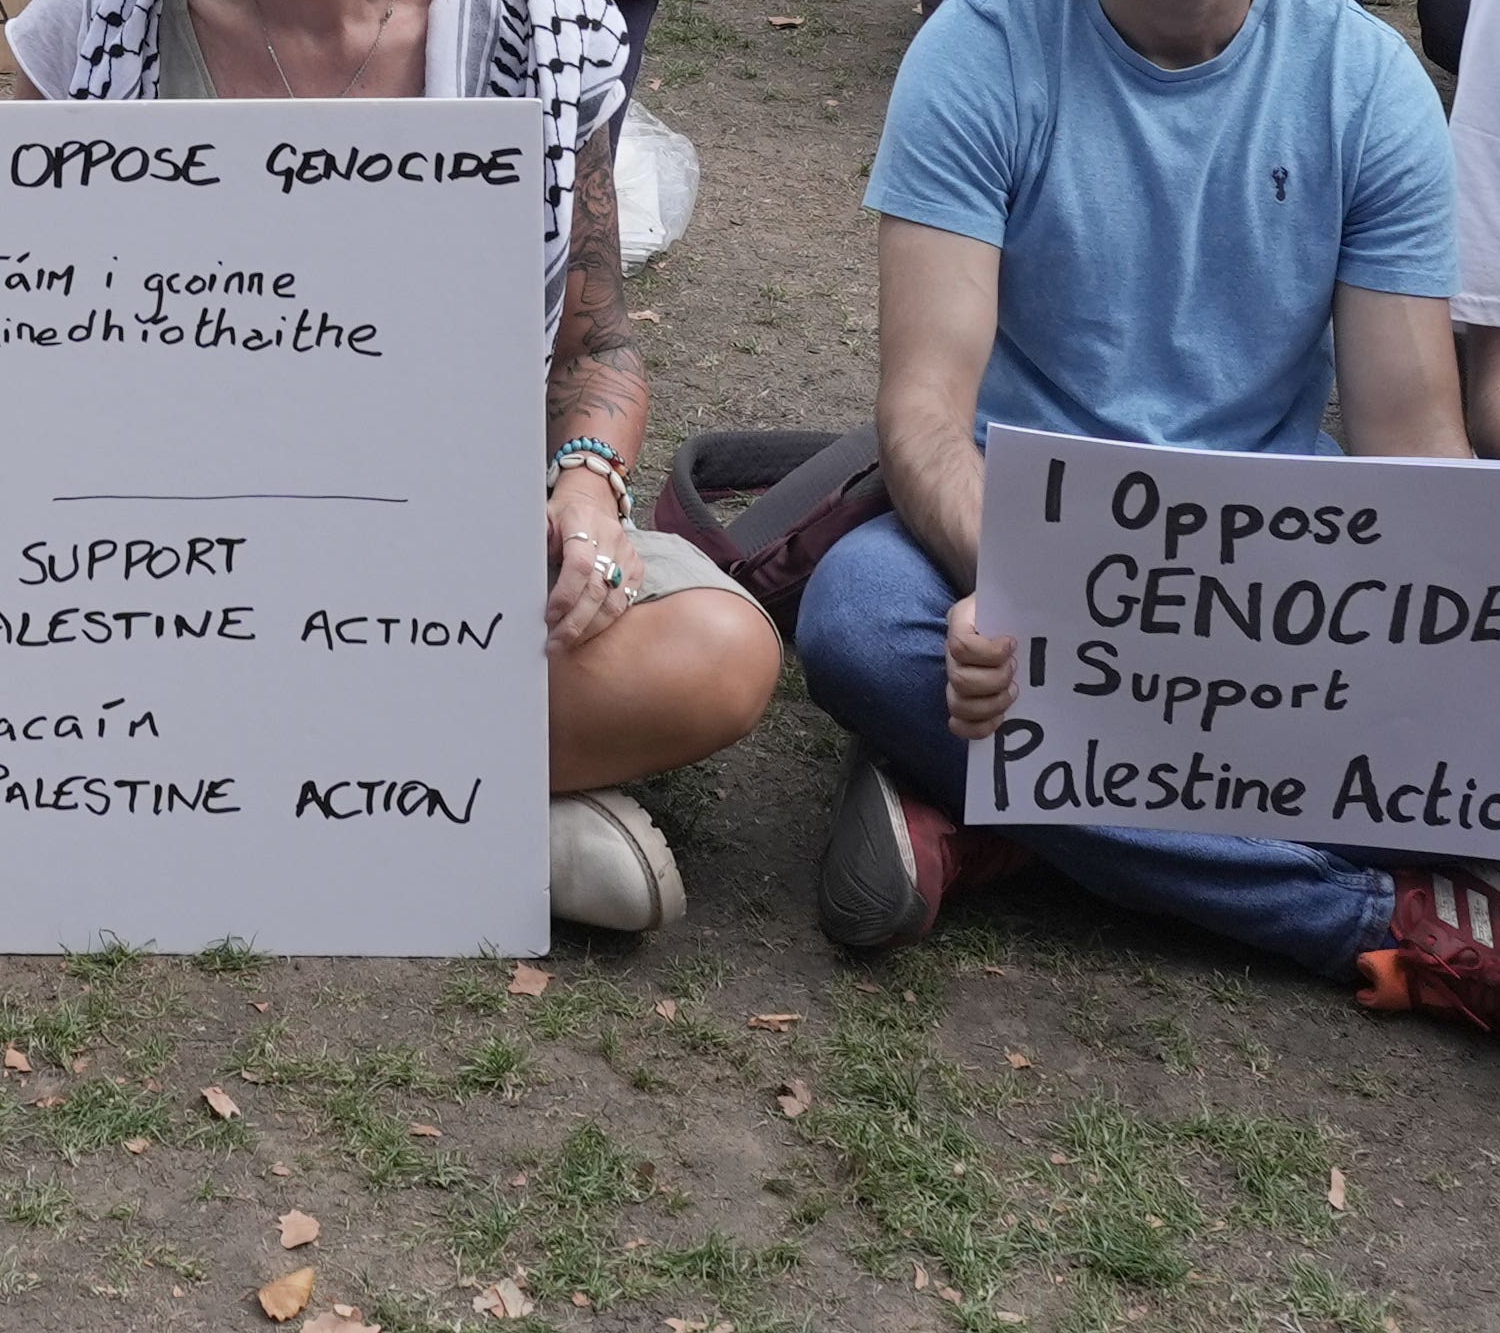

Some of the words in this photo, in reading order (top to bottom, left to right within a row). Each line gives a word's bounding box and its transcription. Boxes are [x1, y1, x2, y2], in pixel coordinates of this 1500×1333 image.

[9, 139, 224, 192] OPPOSE
[264, 142, 524, 195] GENOCIDE
[1044, 458, 1066, 525] I
[1111, 469, 1381, 565] Oppose
[18, 537, 247, 588] SUPPORT
[298, 611, 504, 653] ACTION
[1030, 636, 1046, 688] I
[1073, 639, 1350, 732] Support
[992, 716, 1304, 816] Palestine
[295, 776, 482, 826] ACTION
